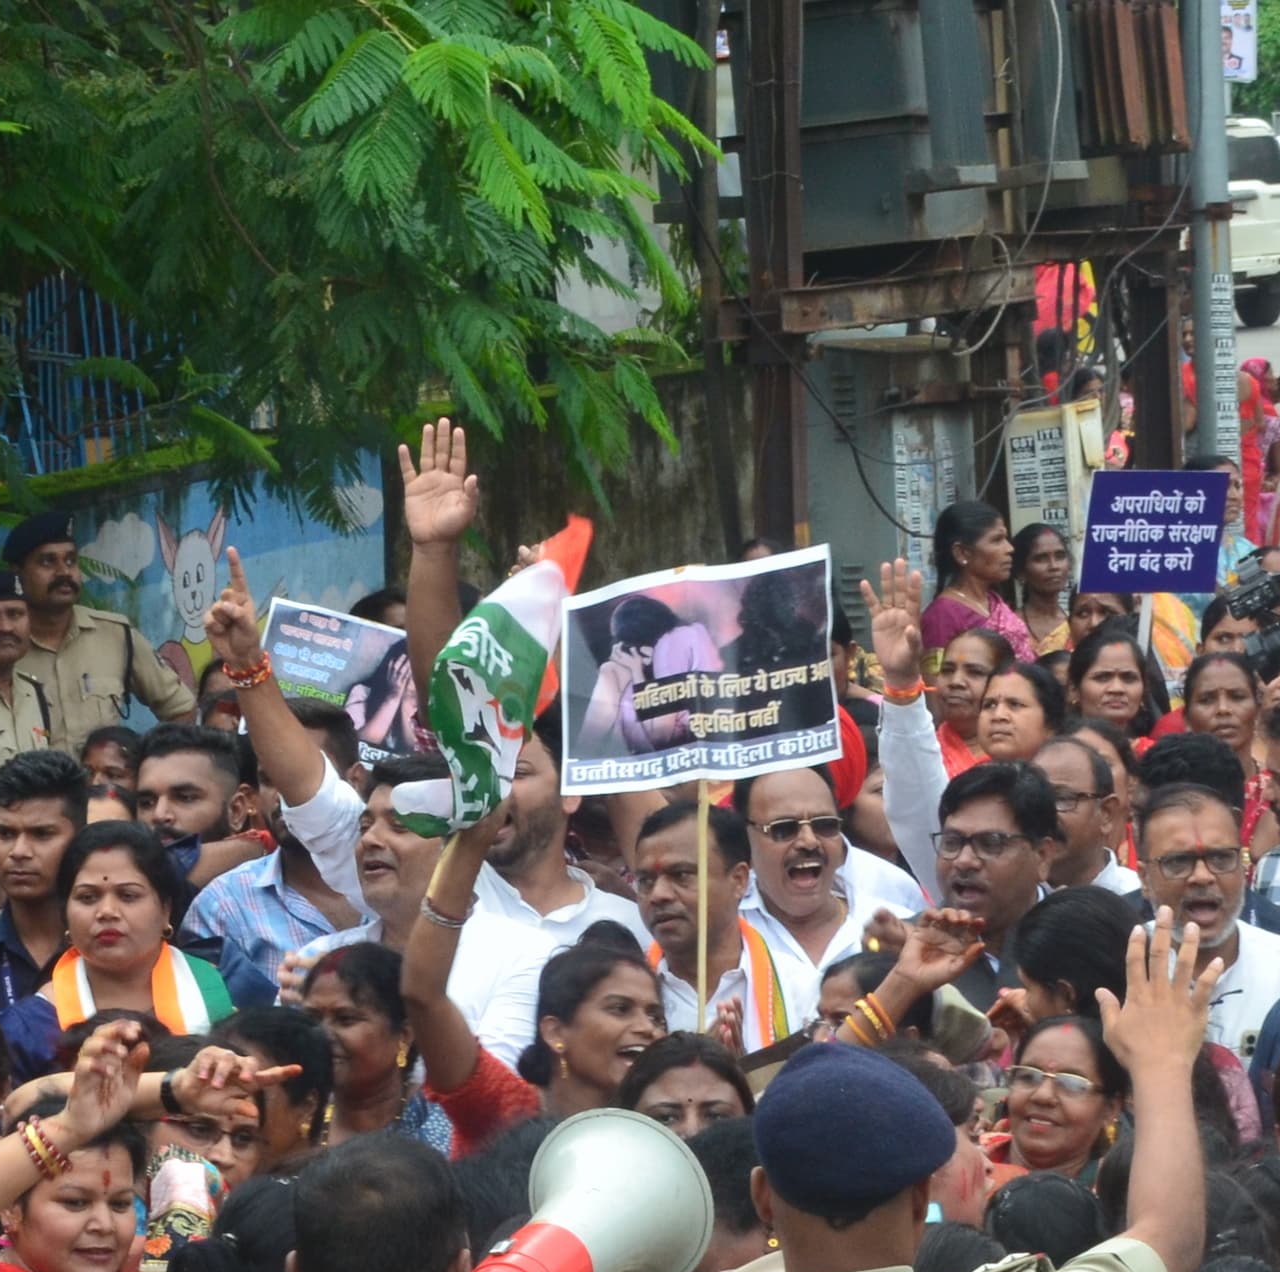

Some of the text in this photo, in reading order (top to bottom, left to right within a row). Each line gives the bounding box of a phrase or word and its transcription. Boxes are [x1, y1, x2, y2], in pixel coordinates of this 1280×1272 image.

[1110, 489, 1206, 514] अपराधियों को
[1091, 518, 1218, 545] राजनीतिक संरक्षण
[1107, 547, 1194, 573] देना बंद करो
[632, 673, 698, 711] महिलाओं
[698, 674, 717, 699] के
[717, 672, 754, 699] लिए
[753, 672, 770, 693] ये
[769, 664, 809, 691] राज्य
[688, 699, 783, 738] सुरक्षित नहीं
[666, 745, 708, 772] प्रदेश
[711, 740, 775, 769] महिला
[777, 728, 836, 757] कांग्रेस
